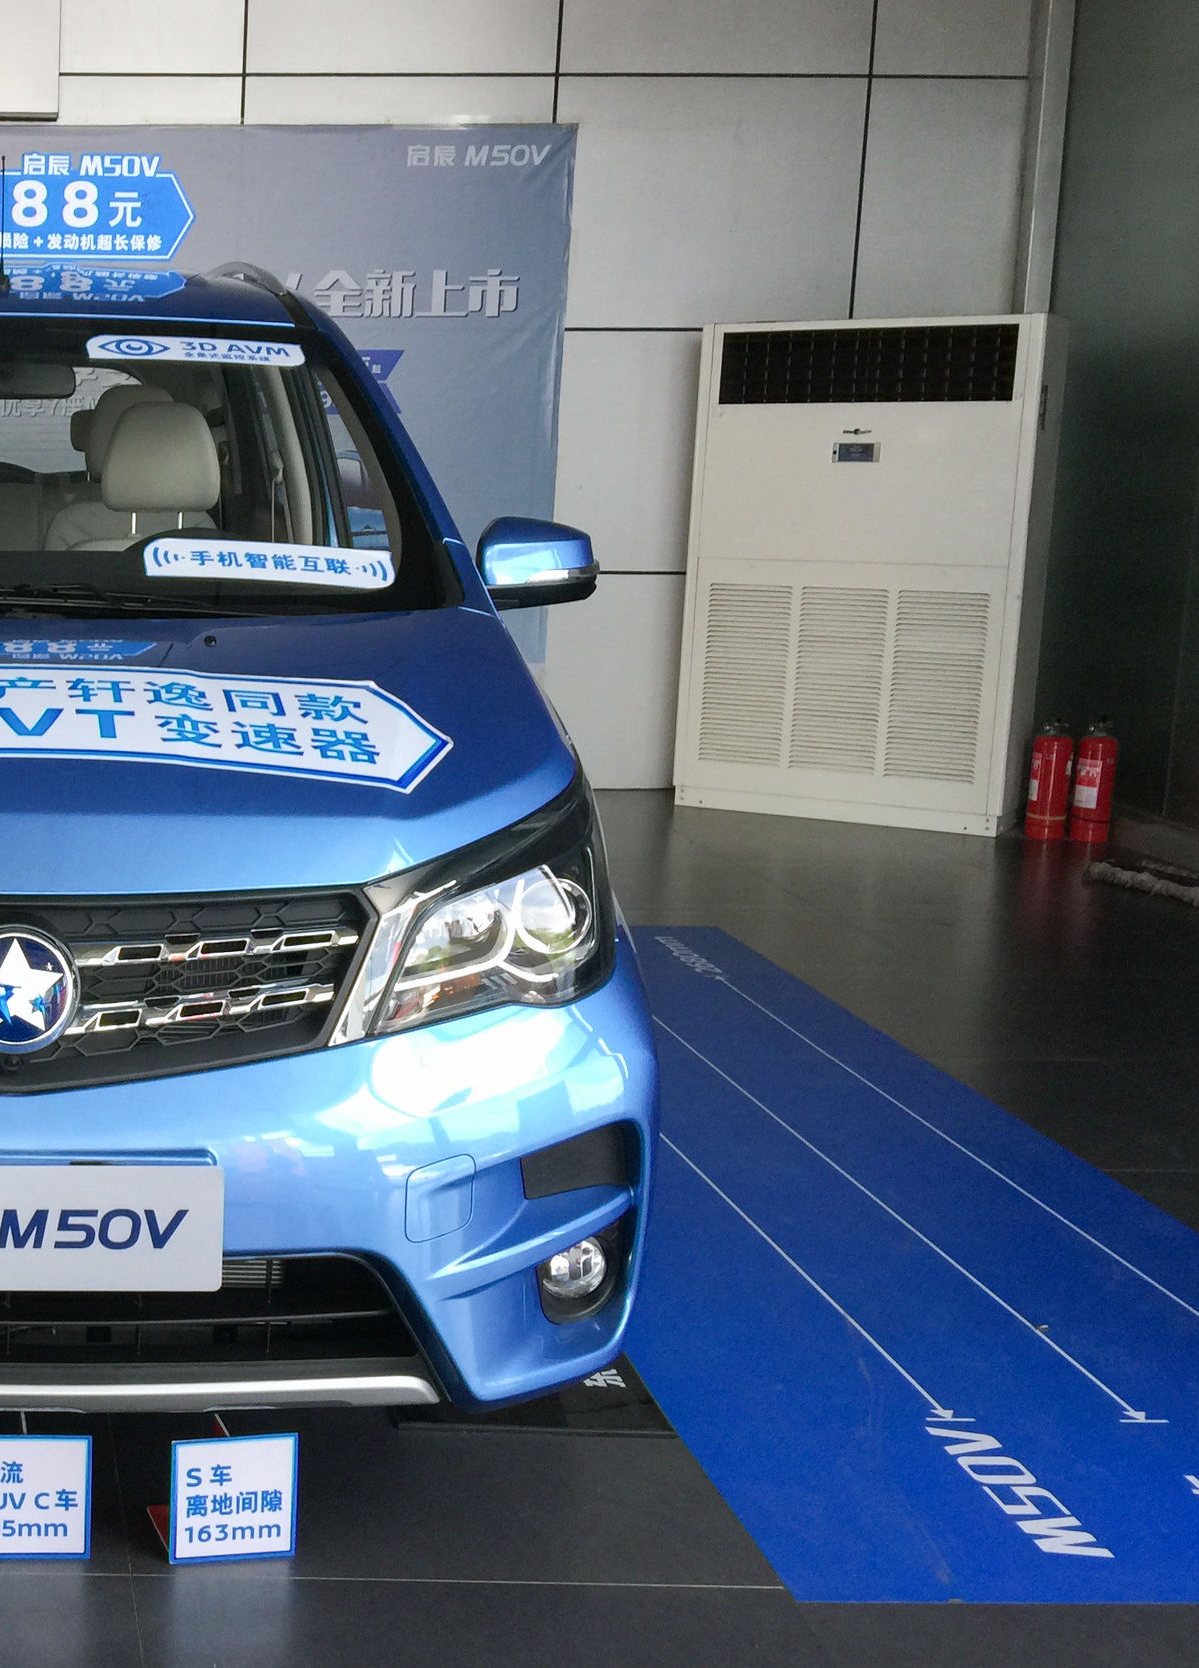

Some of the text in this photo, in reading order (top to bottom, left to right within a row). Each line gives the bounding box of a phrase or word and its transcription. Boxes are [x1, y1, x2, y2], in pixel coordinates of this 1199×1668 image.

[23, 153, 160, 177] 启辰 M50V
[407, 144, 551, 167] 启辰 M50V
[313, 269, 520, 318] 全新上市
[180, 341, 290, 357] 3D AVM
[190, 549, 352, 576] 手机智能互联
[156, 712, 381, 765] 变速器
[186, 1464, 232, 1487] S 车
[186, 1490, 283, 1517] 离地间隙
[925, 1427, 1115, 1558] M50V
[185, 1524, 282, 1543] 163mm
